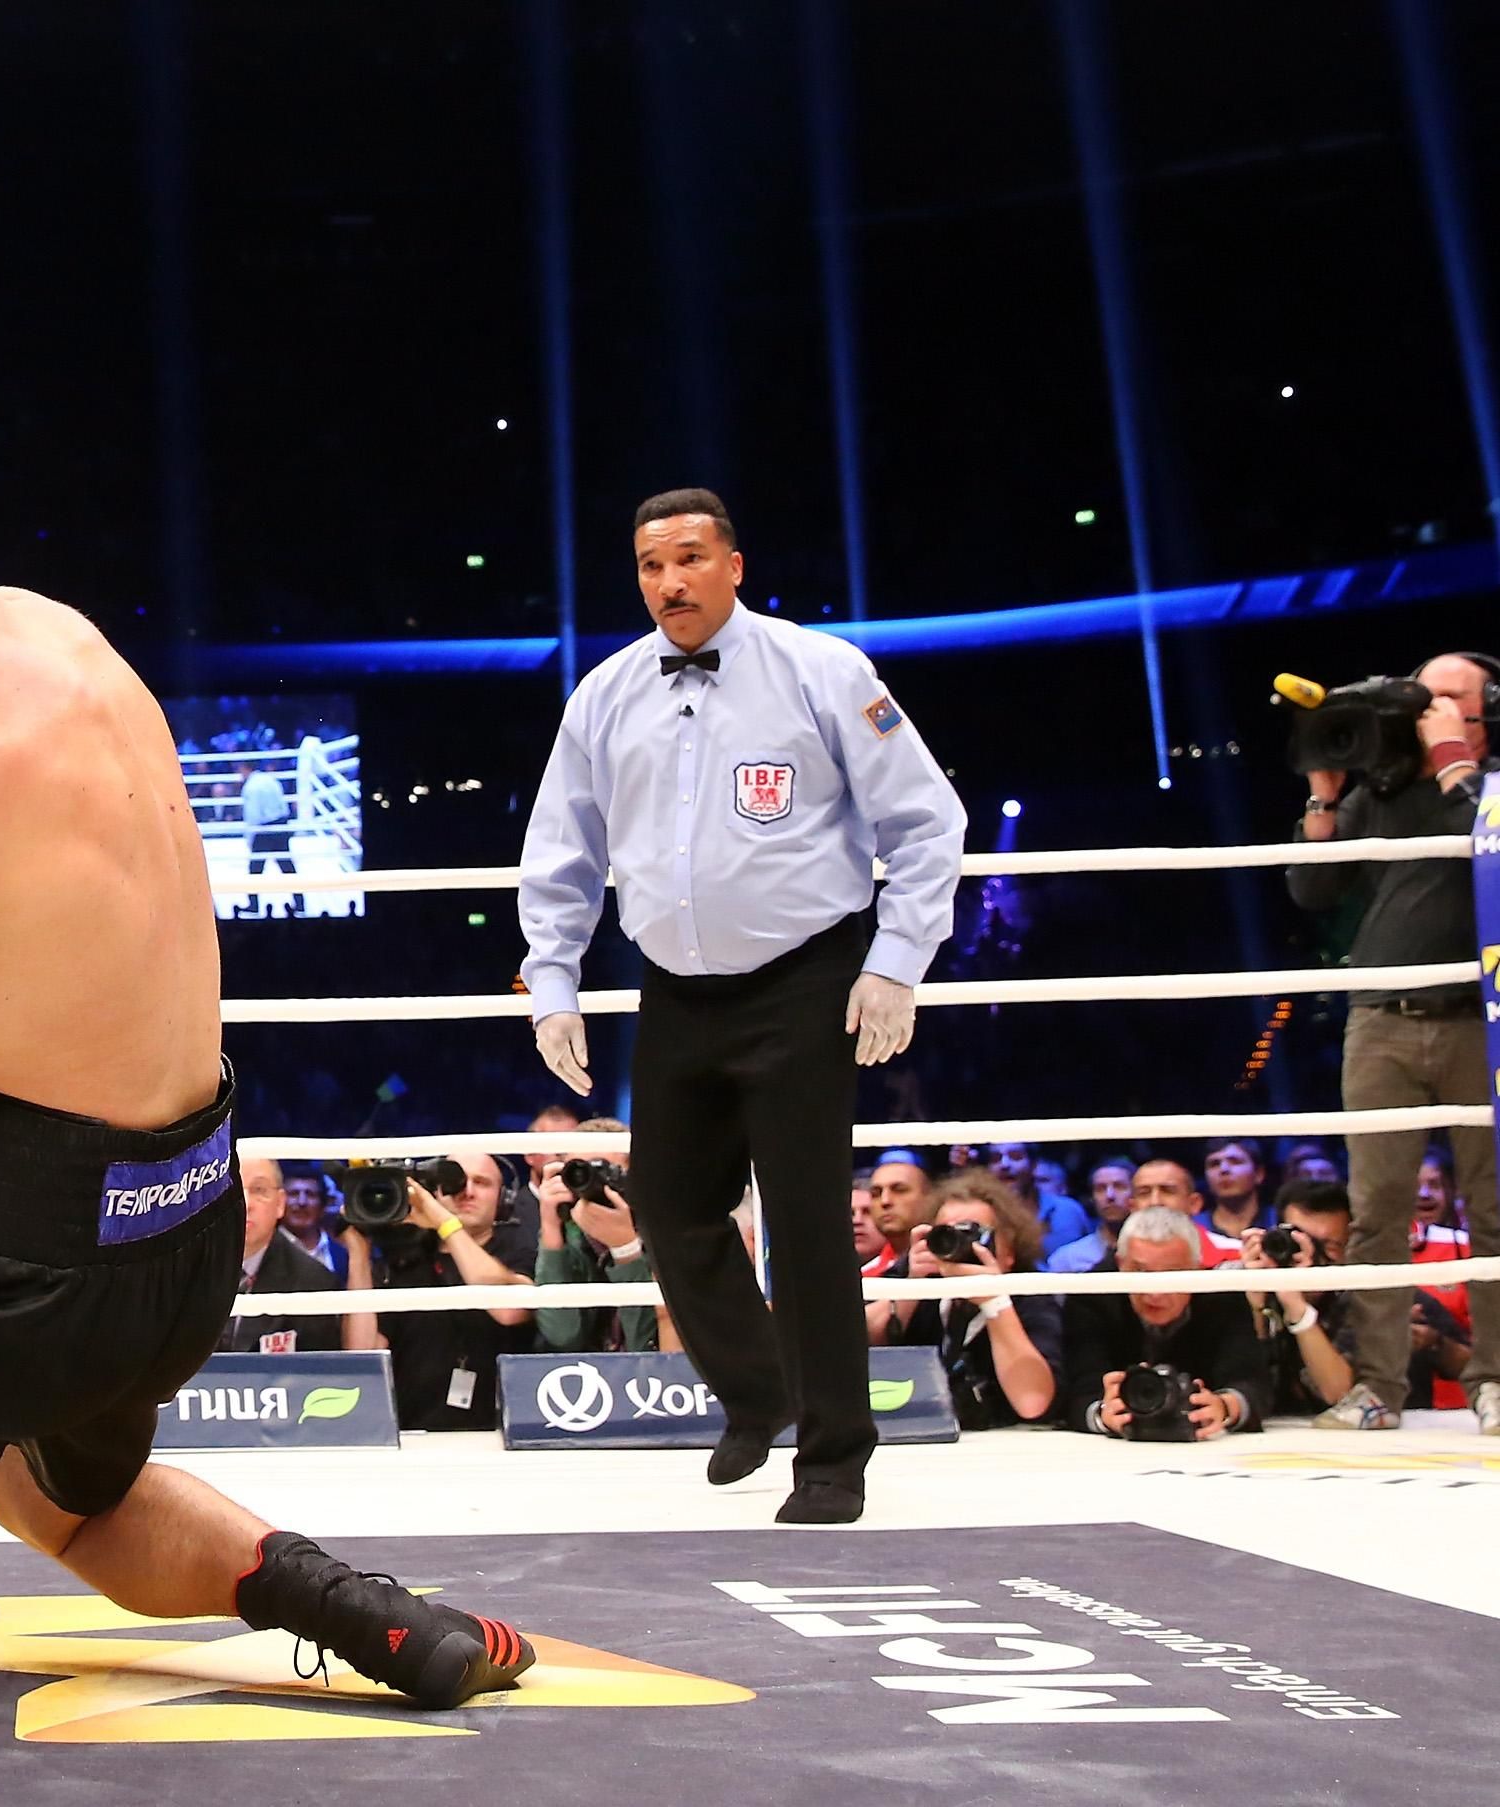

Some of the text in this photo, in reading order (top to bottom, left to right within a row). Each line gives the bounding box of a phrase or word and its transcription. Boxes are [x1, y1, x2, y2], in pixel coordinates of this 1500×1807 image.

[172, 1387, 289, 1421] ТИЦЯ
[711, 1580, 1232, 1724] McFIT
[1119, 1628, 1252, 1655] gut
[1182, 1655, 1402, 1721] Einfach
